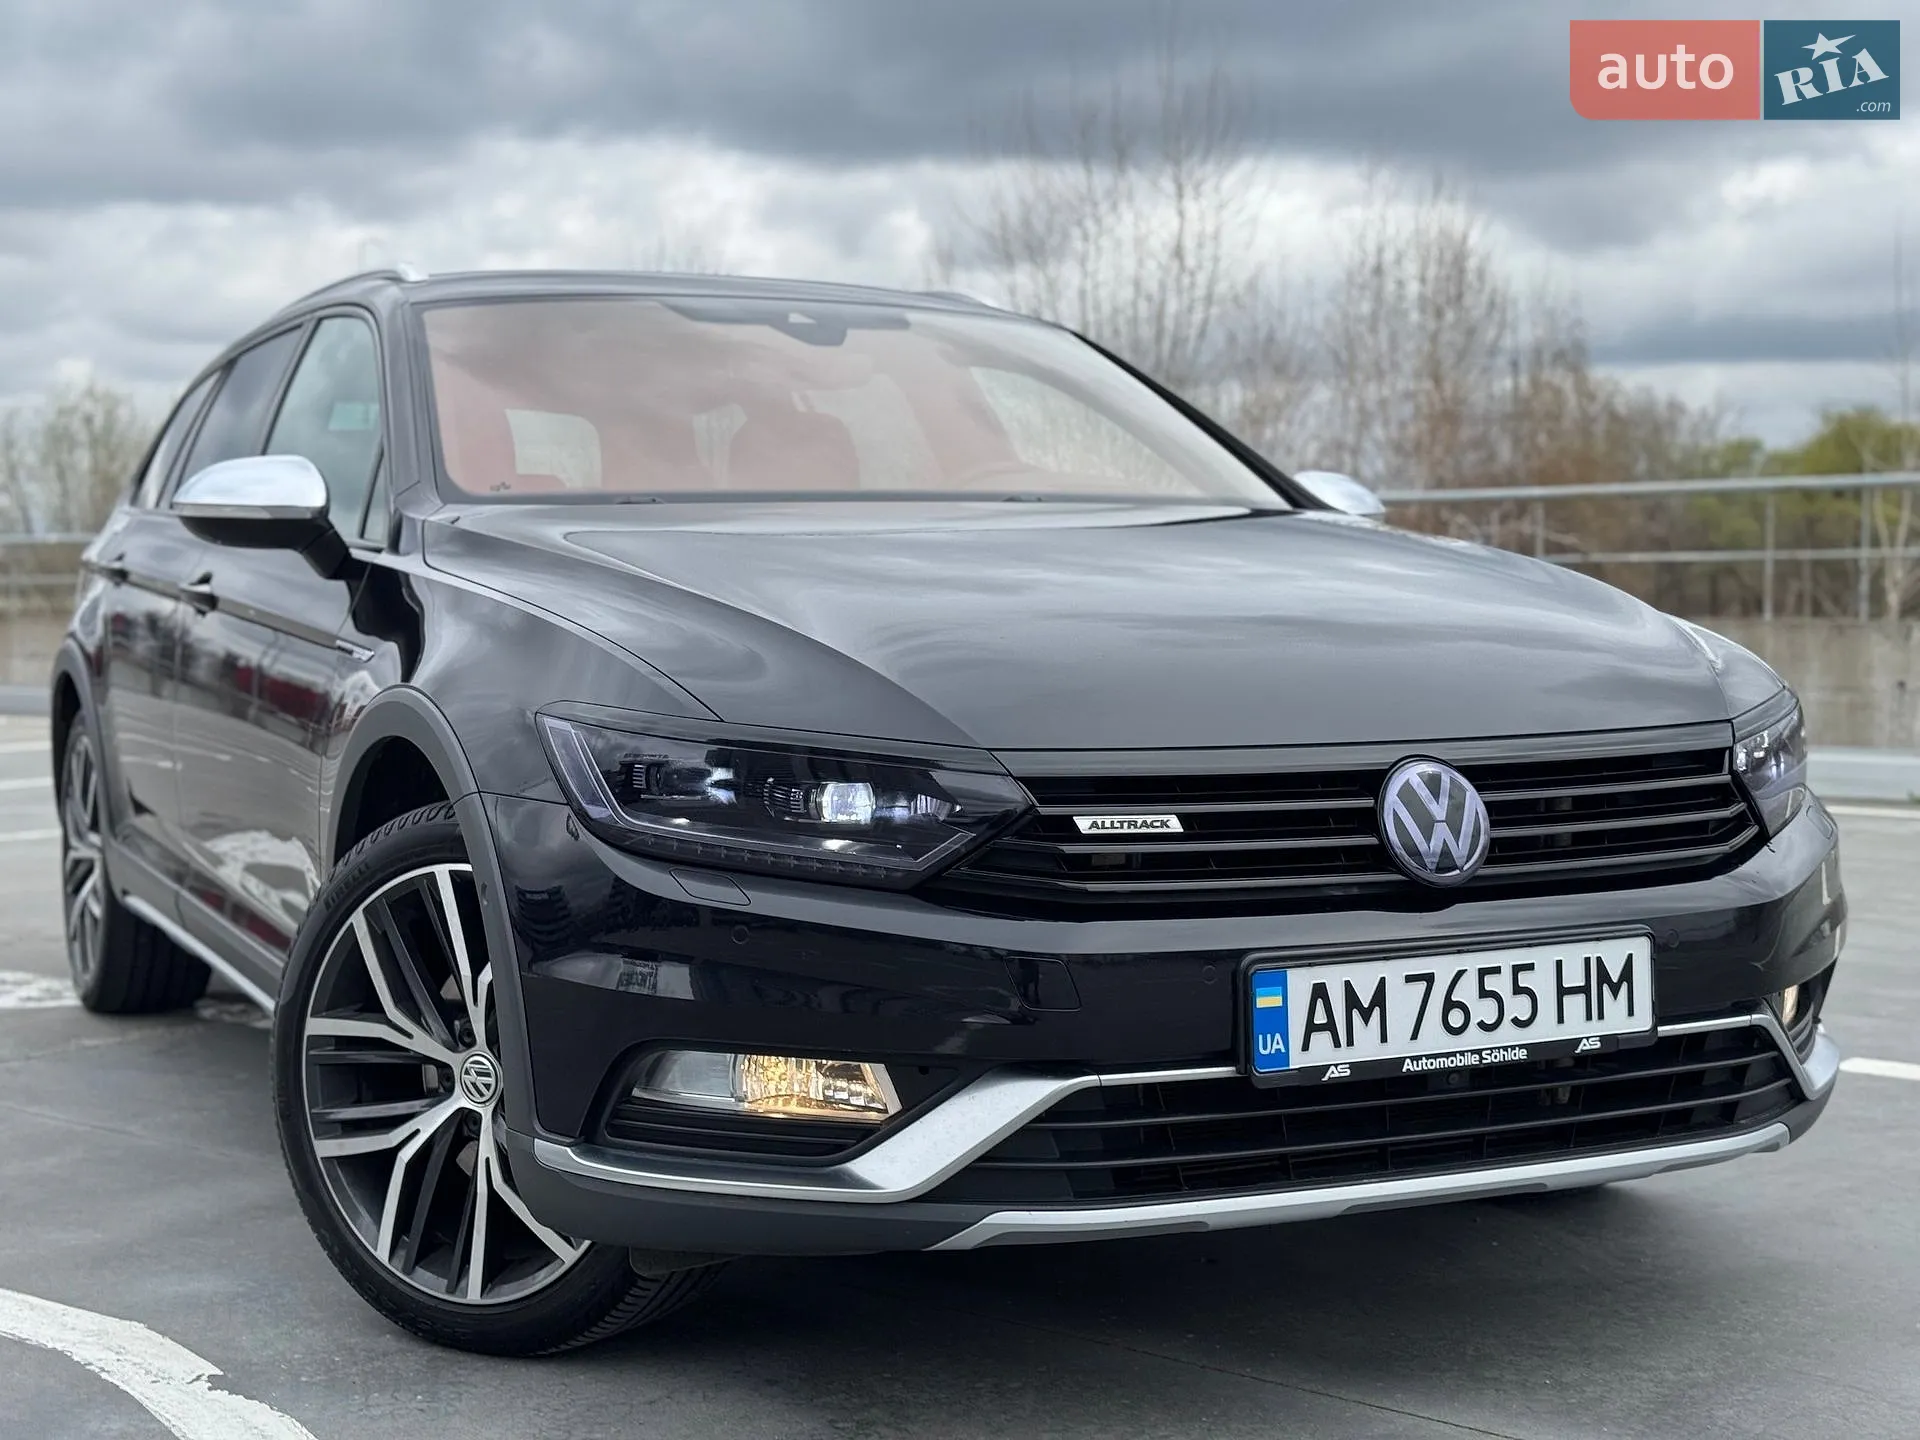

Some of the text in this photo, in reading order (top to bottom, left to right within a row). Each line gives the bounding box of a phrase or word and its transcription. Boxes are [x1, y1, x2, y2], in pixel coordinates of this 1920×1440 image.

[1088, 819, 1171, 830] ALLTRACK
[1300, 953, 1635, 1052] AM 7655 HM
[1258, 1033, 1286, 1056] UA
[1574, 1037, 1601, 1053] AS
[1402, 1047, 1528, 1073] Automobile Söhlde
[1322, 1065, 1351, 1081] AS
